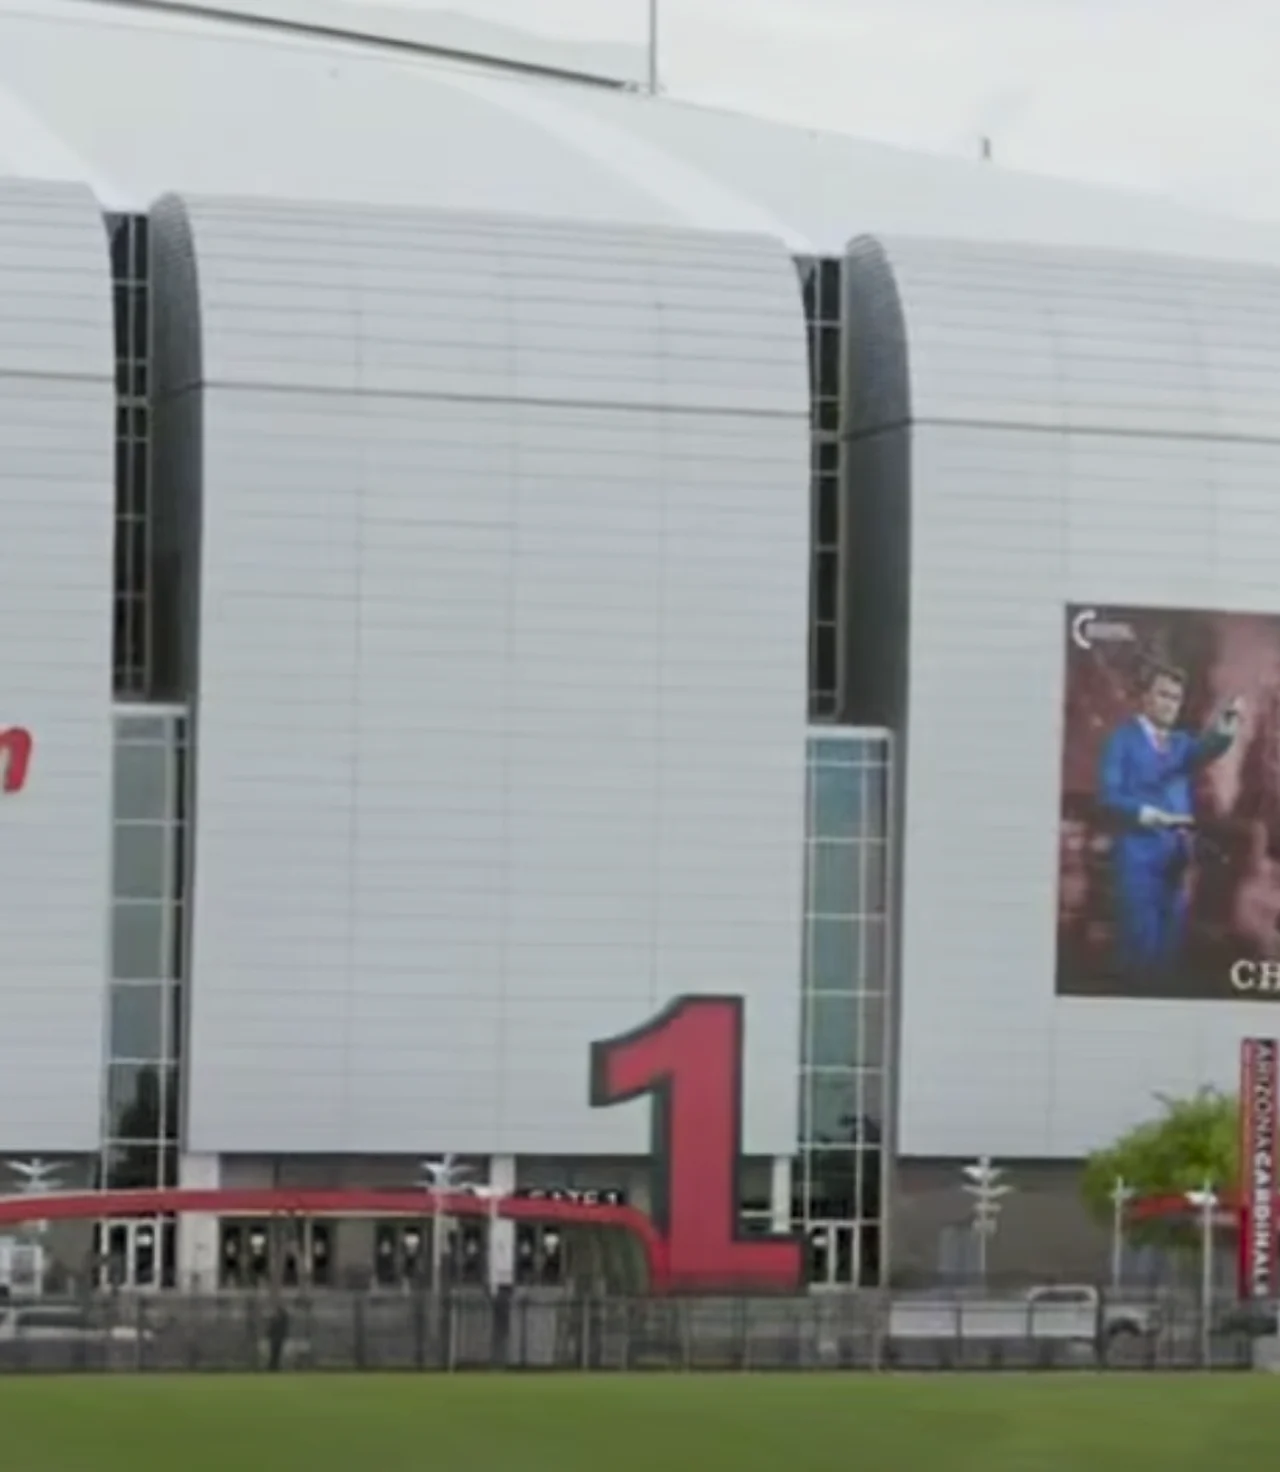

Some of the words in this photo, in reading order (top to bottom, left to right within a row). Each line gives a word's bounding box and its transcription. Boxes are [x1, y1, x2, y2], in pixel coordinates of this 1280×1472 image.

[589, 994, 808, 1296] 1
[1253, 1042, 1273, 1149] ARIZONA
[1253, 1150, 1273, 1296] CARDINALS
